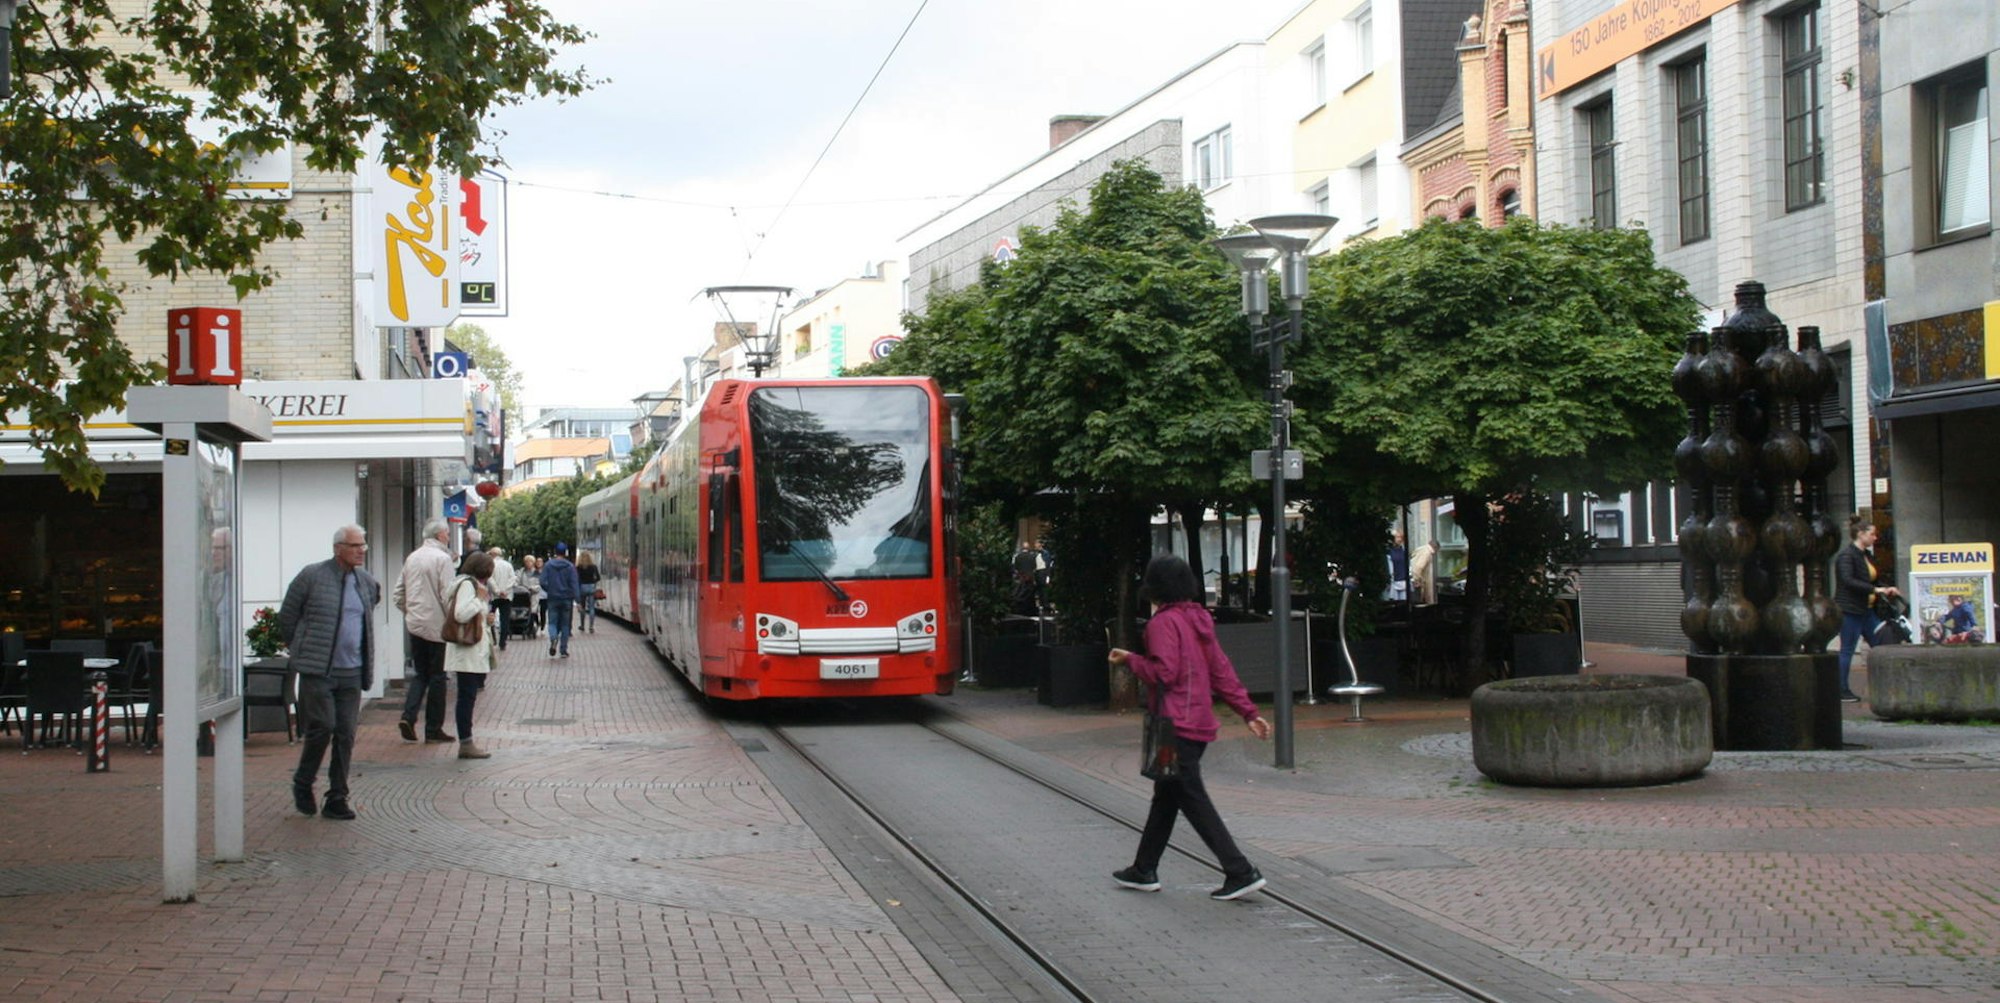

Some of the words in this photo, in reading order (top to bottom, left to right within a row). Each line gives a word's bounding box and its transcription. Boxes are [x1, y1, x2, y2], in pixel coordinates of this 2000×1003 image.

[1570, 28, 1591, 57] 150
[1595, 13, 1627, 44] Jahre
[1644, 18, 1665, 42] 1862
[1678, 1, 1702, 26] 2012
[175, 314, 195, 376] i
[210, 314, 235, 377] i
[1918, 551, 1987, 564] ZEEMAN
[835, 665, 867, 674] 4061
